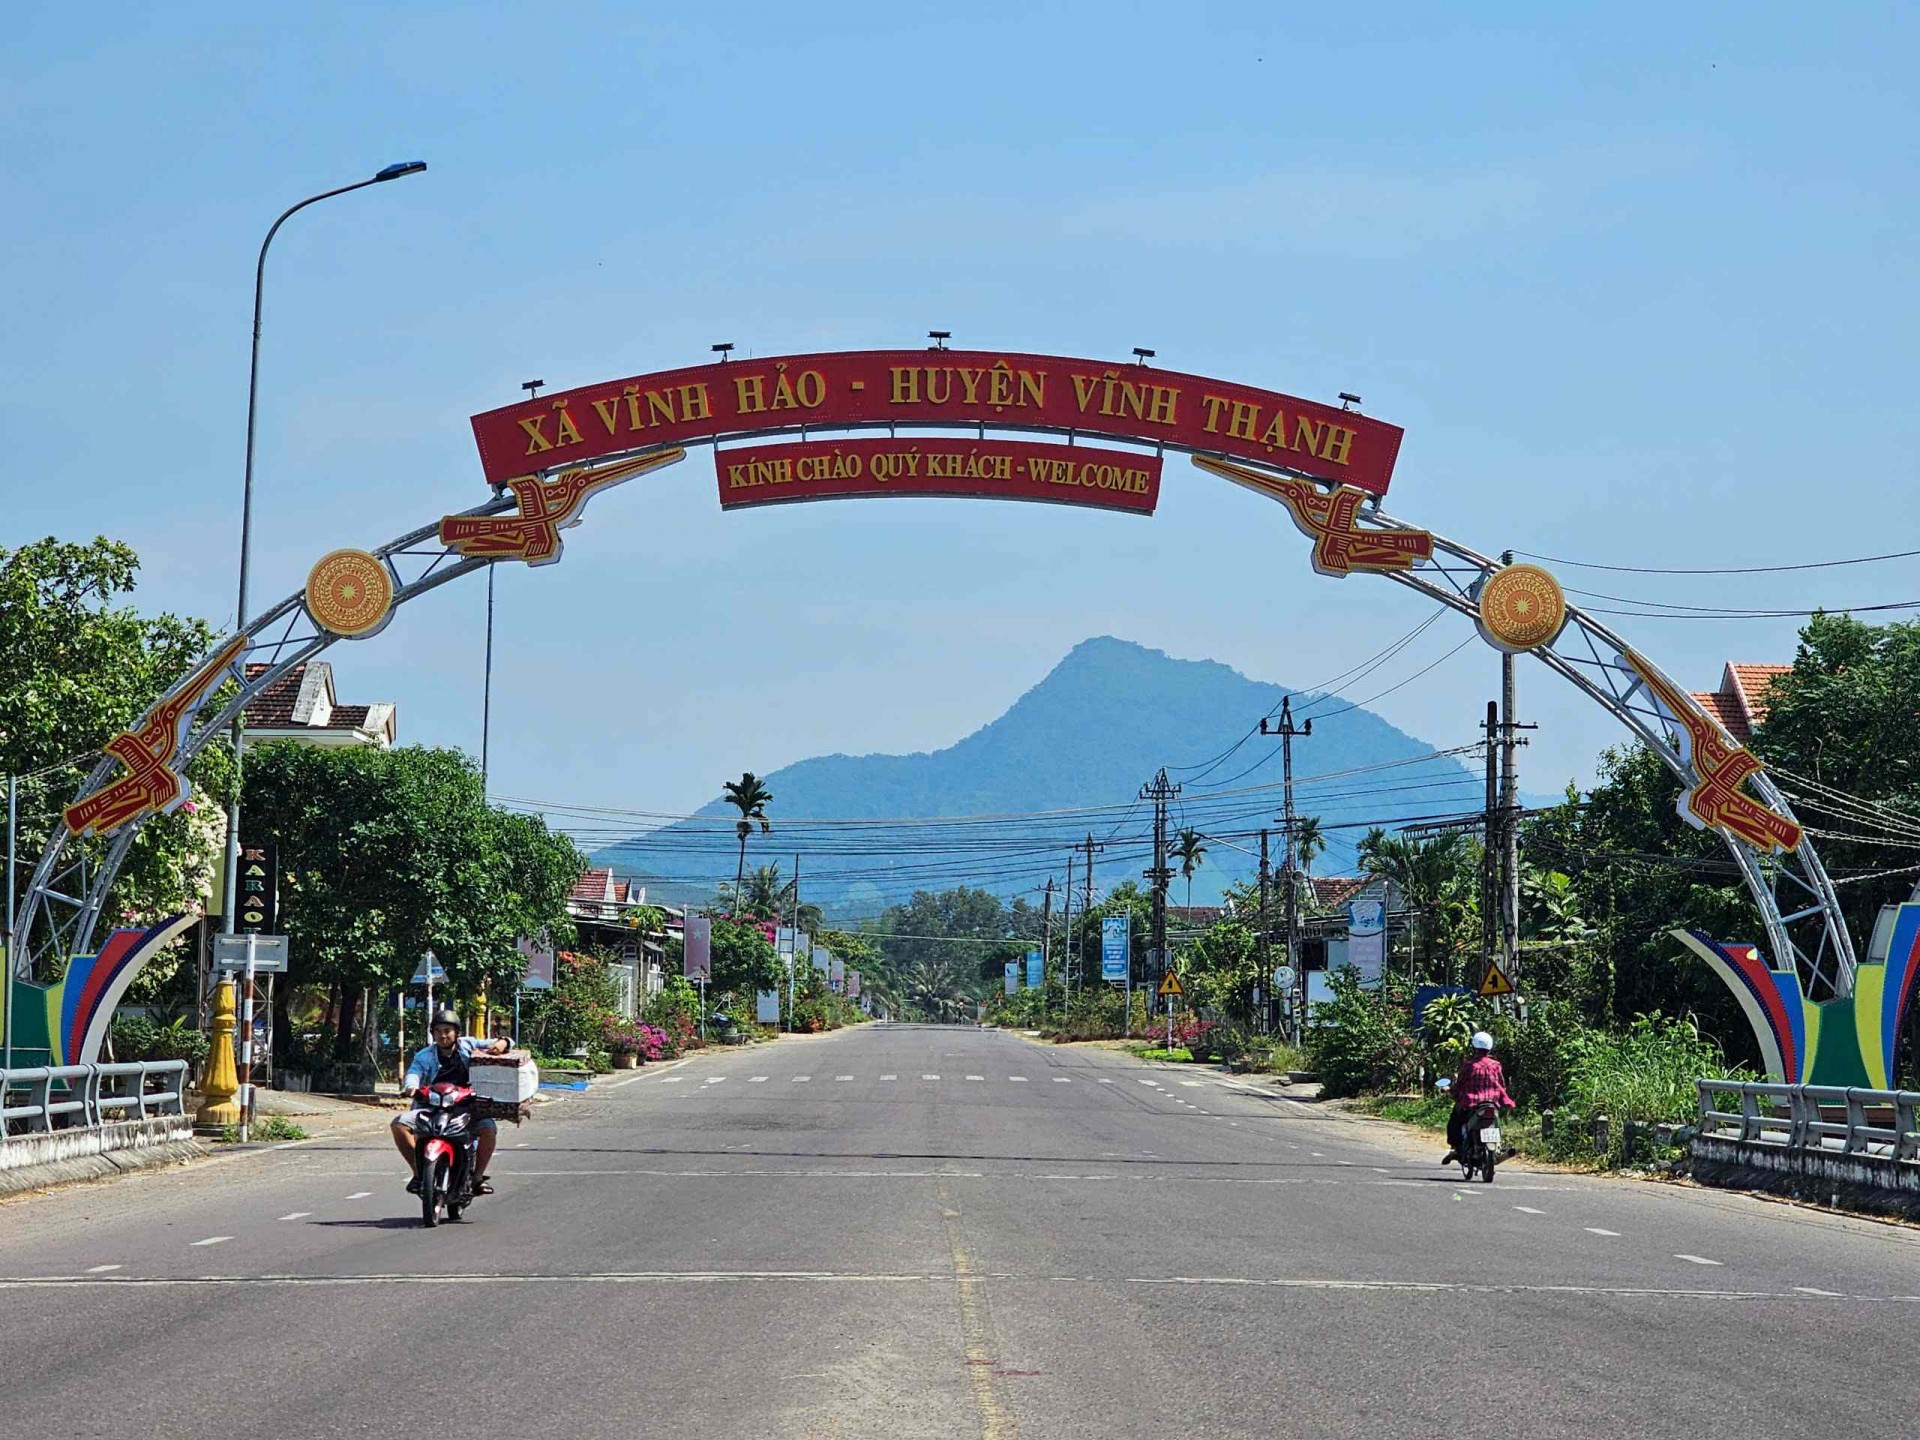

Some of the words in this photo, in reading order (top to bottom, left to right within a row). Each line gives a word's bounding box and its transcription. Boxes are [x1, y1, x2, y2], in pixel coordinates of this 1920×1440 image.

[517, 400, 584, 456] XÃ
[592, 383, 712, 435] VĨNH
[733, 363, 826, 414] HẢO
[889, 359, 1047, 413] HUYỆN
[1070, 370, 1181, 425] VĨNH
[1202, 395, 1357, 466] THẠNH
[728, 456, 793, 489] KÍNH
[796, 449, 862, 480] CHÀO
[870, 446, 921, 482] QUÝ
